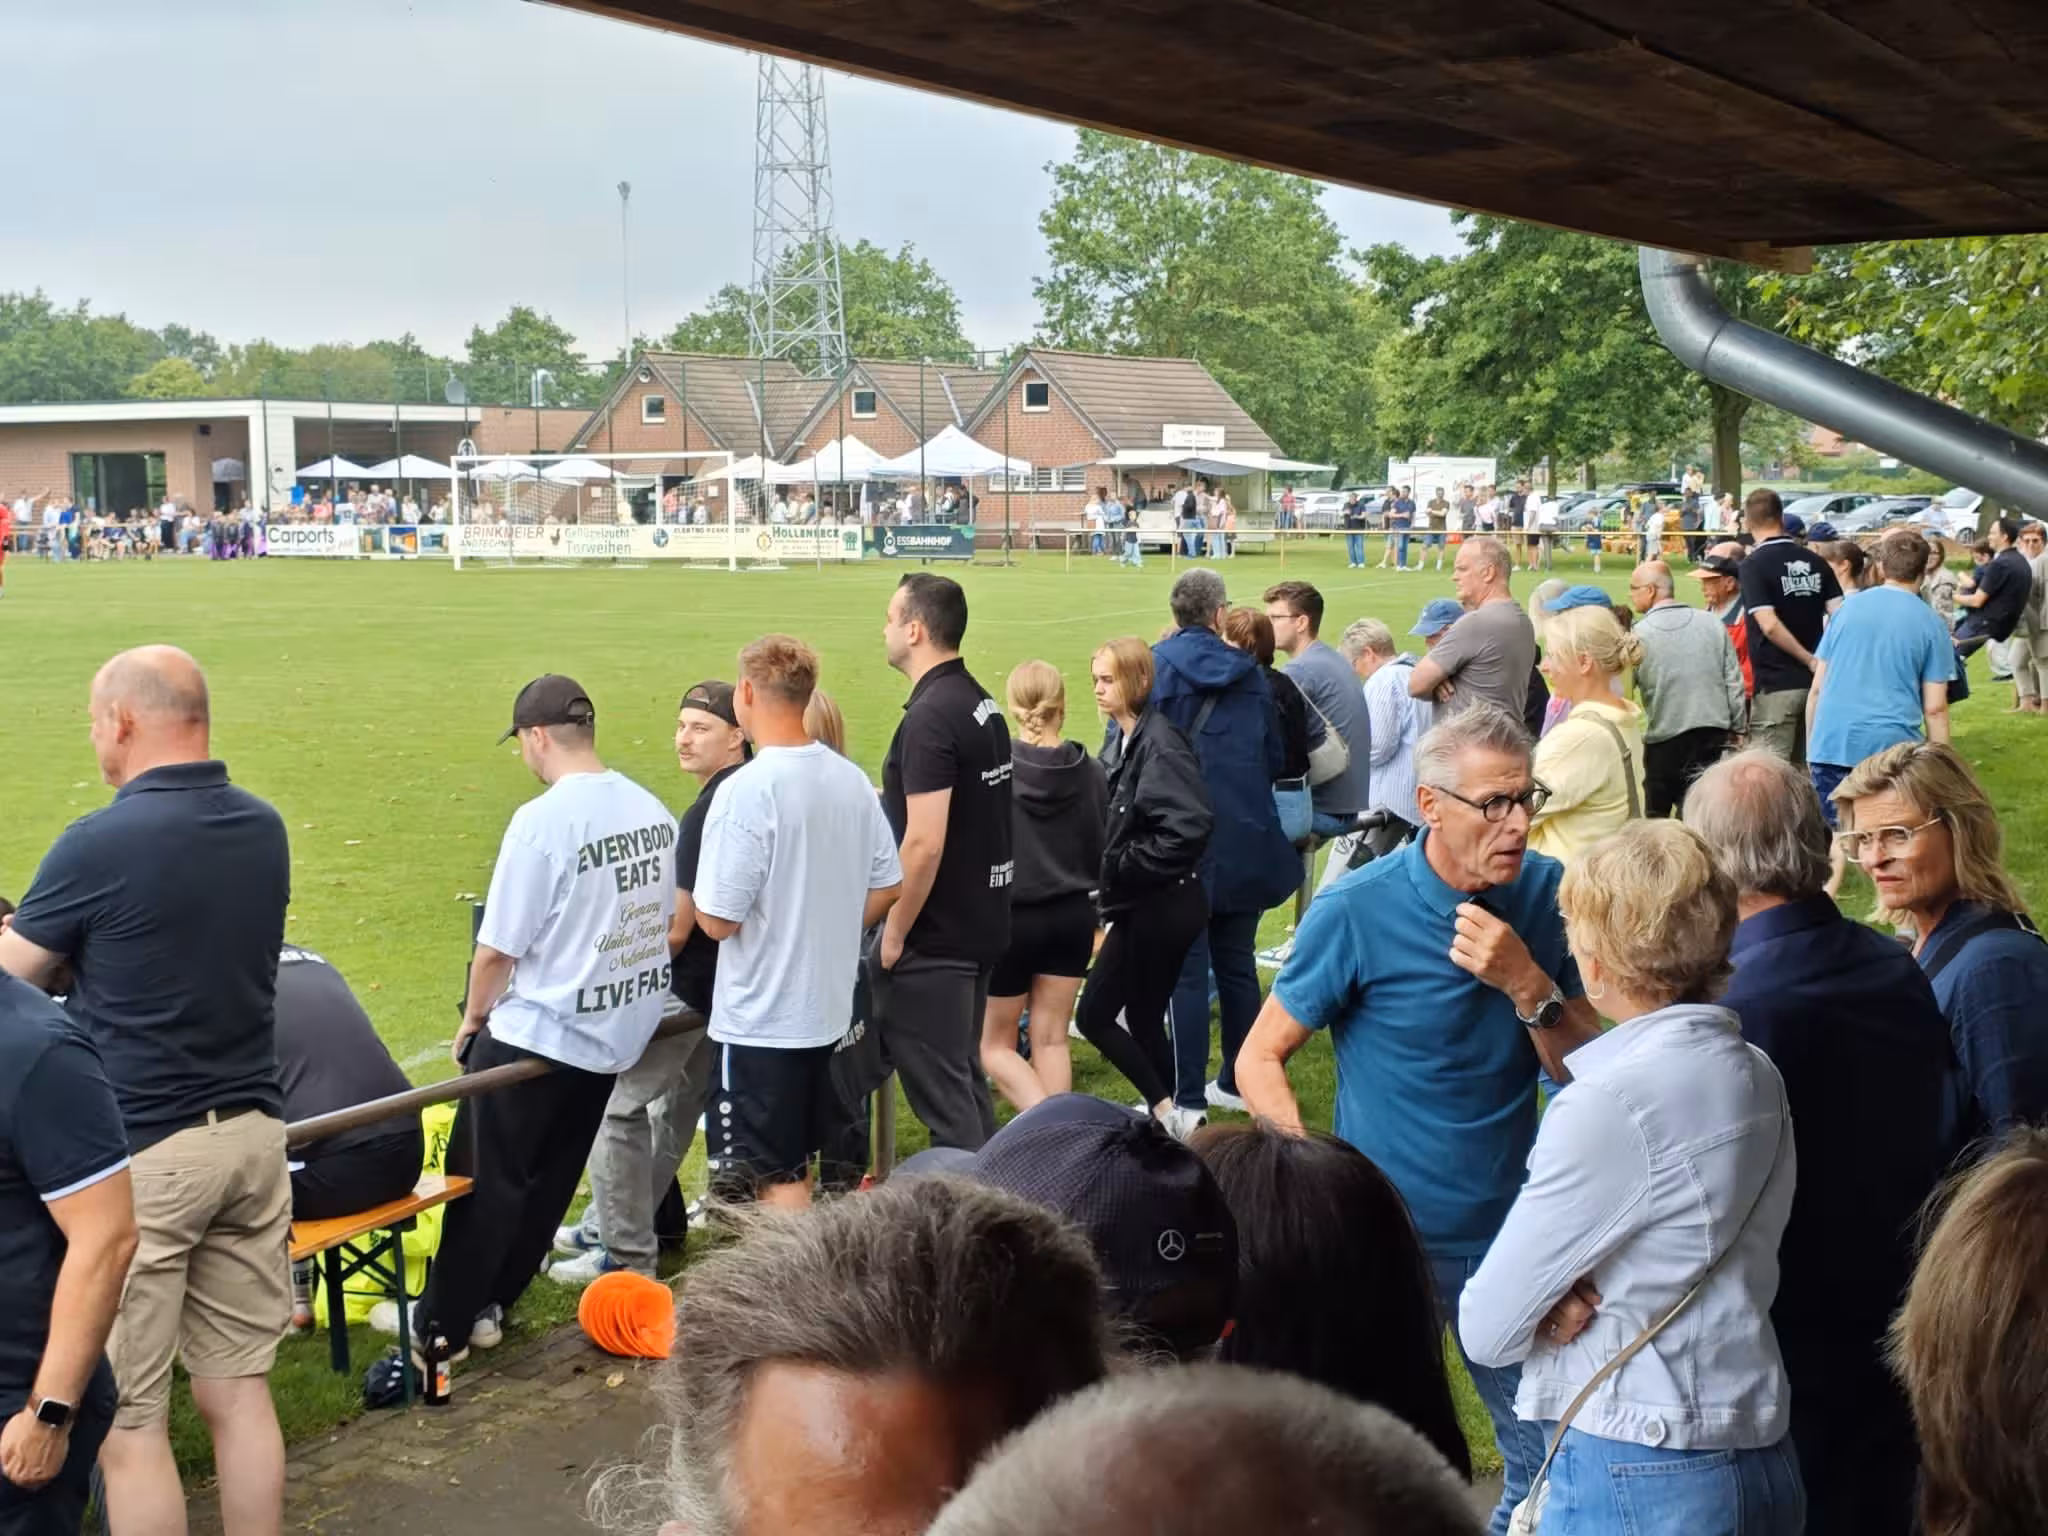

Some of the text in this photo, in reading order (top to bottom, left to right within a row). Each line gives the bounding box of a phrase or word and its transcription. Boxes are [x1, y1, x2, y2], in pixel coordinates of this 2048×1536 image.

[268, 527, 334, 547] Carports
[463, 526, 544, 539] BRINKMEIER
[896, 535, 952, 546] ESSBAHNHOF
[615, 855, 661, 893] EATS
[593, 927, 635, 952] United
[576, 962, 672, 1013] LIVE FAS
